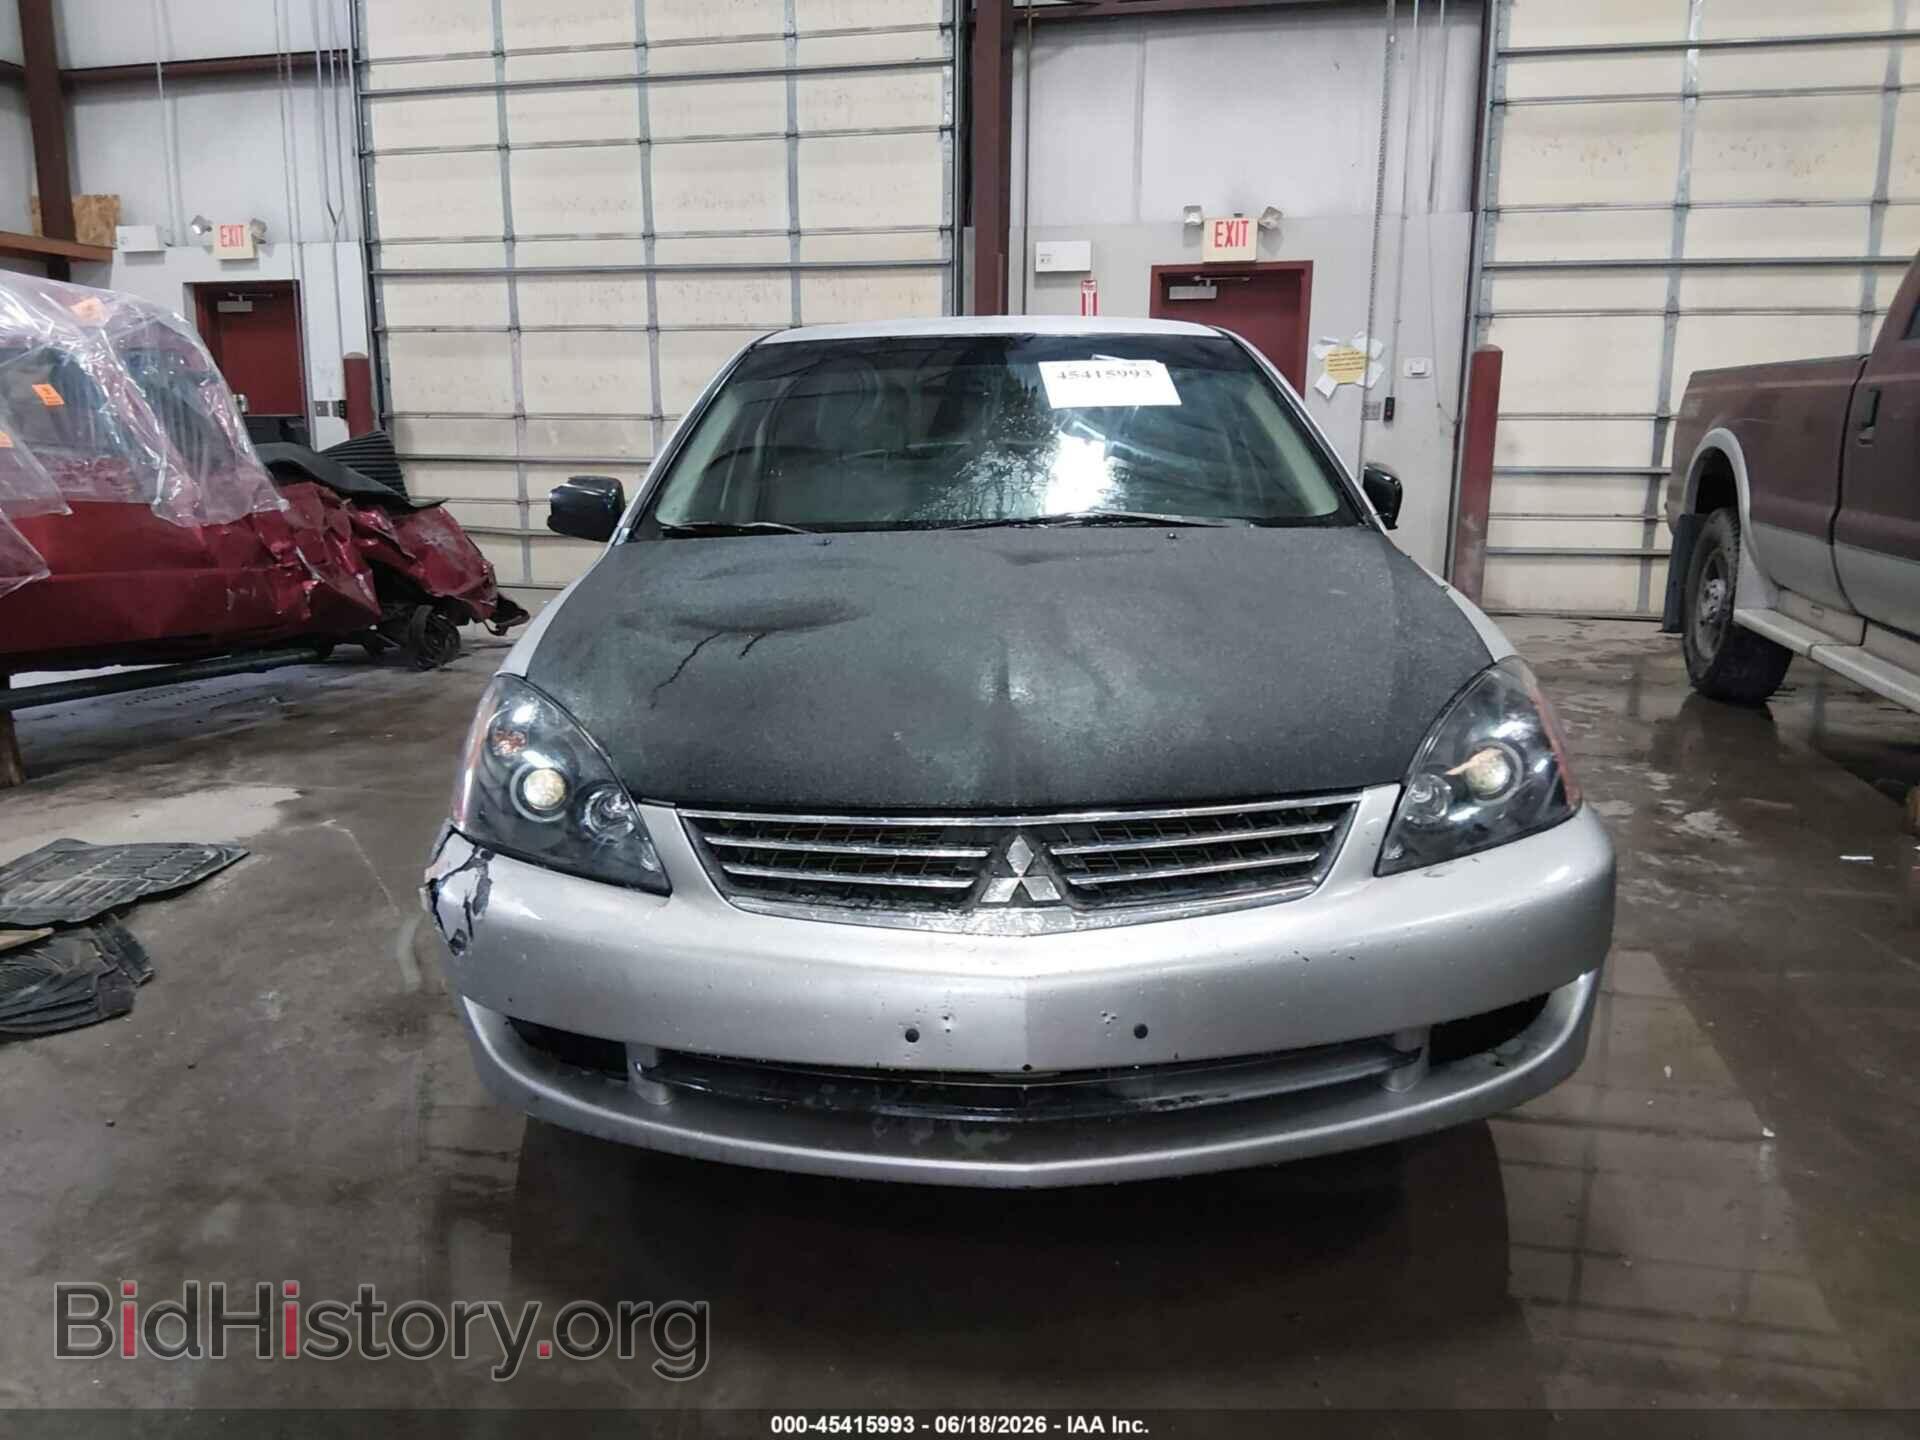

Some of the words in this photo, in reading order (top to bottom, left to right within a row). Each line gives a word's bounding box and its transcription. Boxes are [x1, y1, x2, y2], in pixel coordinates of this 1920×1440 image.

[220, 224, 244, 247] EXIT
[1214, 220, 1249, 248] EXIT
[1057, 369, 1153, 380] 45415993
